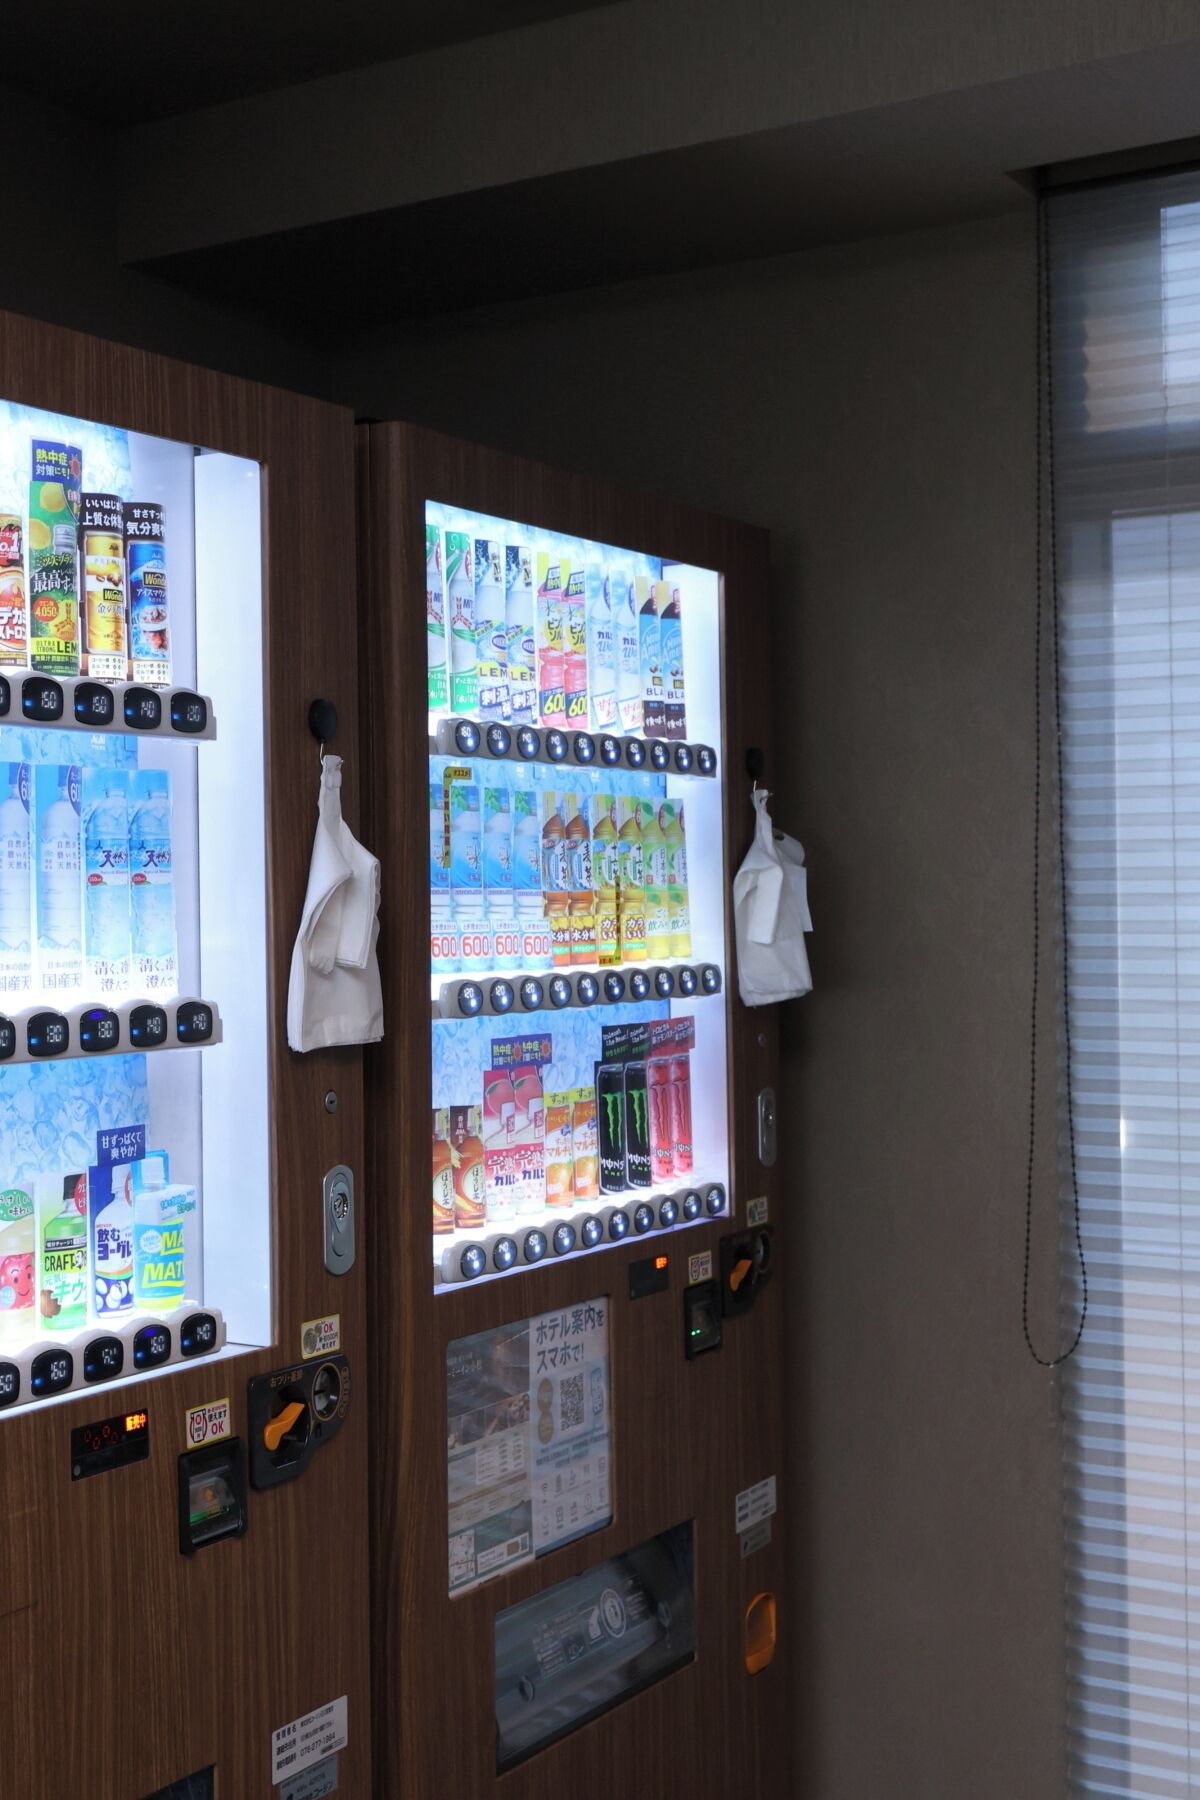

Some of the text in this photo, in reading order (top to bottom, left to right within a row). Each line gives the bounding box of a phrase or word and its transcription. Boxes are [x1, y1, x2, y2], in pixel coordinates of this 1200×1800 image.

[35, 447, 68, 467] 熱中症
[35, 463, 71, 481] 対策にも!
[462, 935, 491, 958] 600
[495, 935, 519, 957] 600
[523, 935, 549, 956] 600
[471, 1168, 480, 1199] ほうじ茶
[97, 1229, 121, 1243] 飲む
[323, 1323, 334, 1333] OK
[536, 1304, 605, 1346] ホテル案内を
[536, 1342, 585, 1375] スマホで!
[211, 1422, 224, 1435] OK
